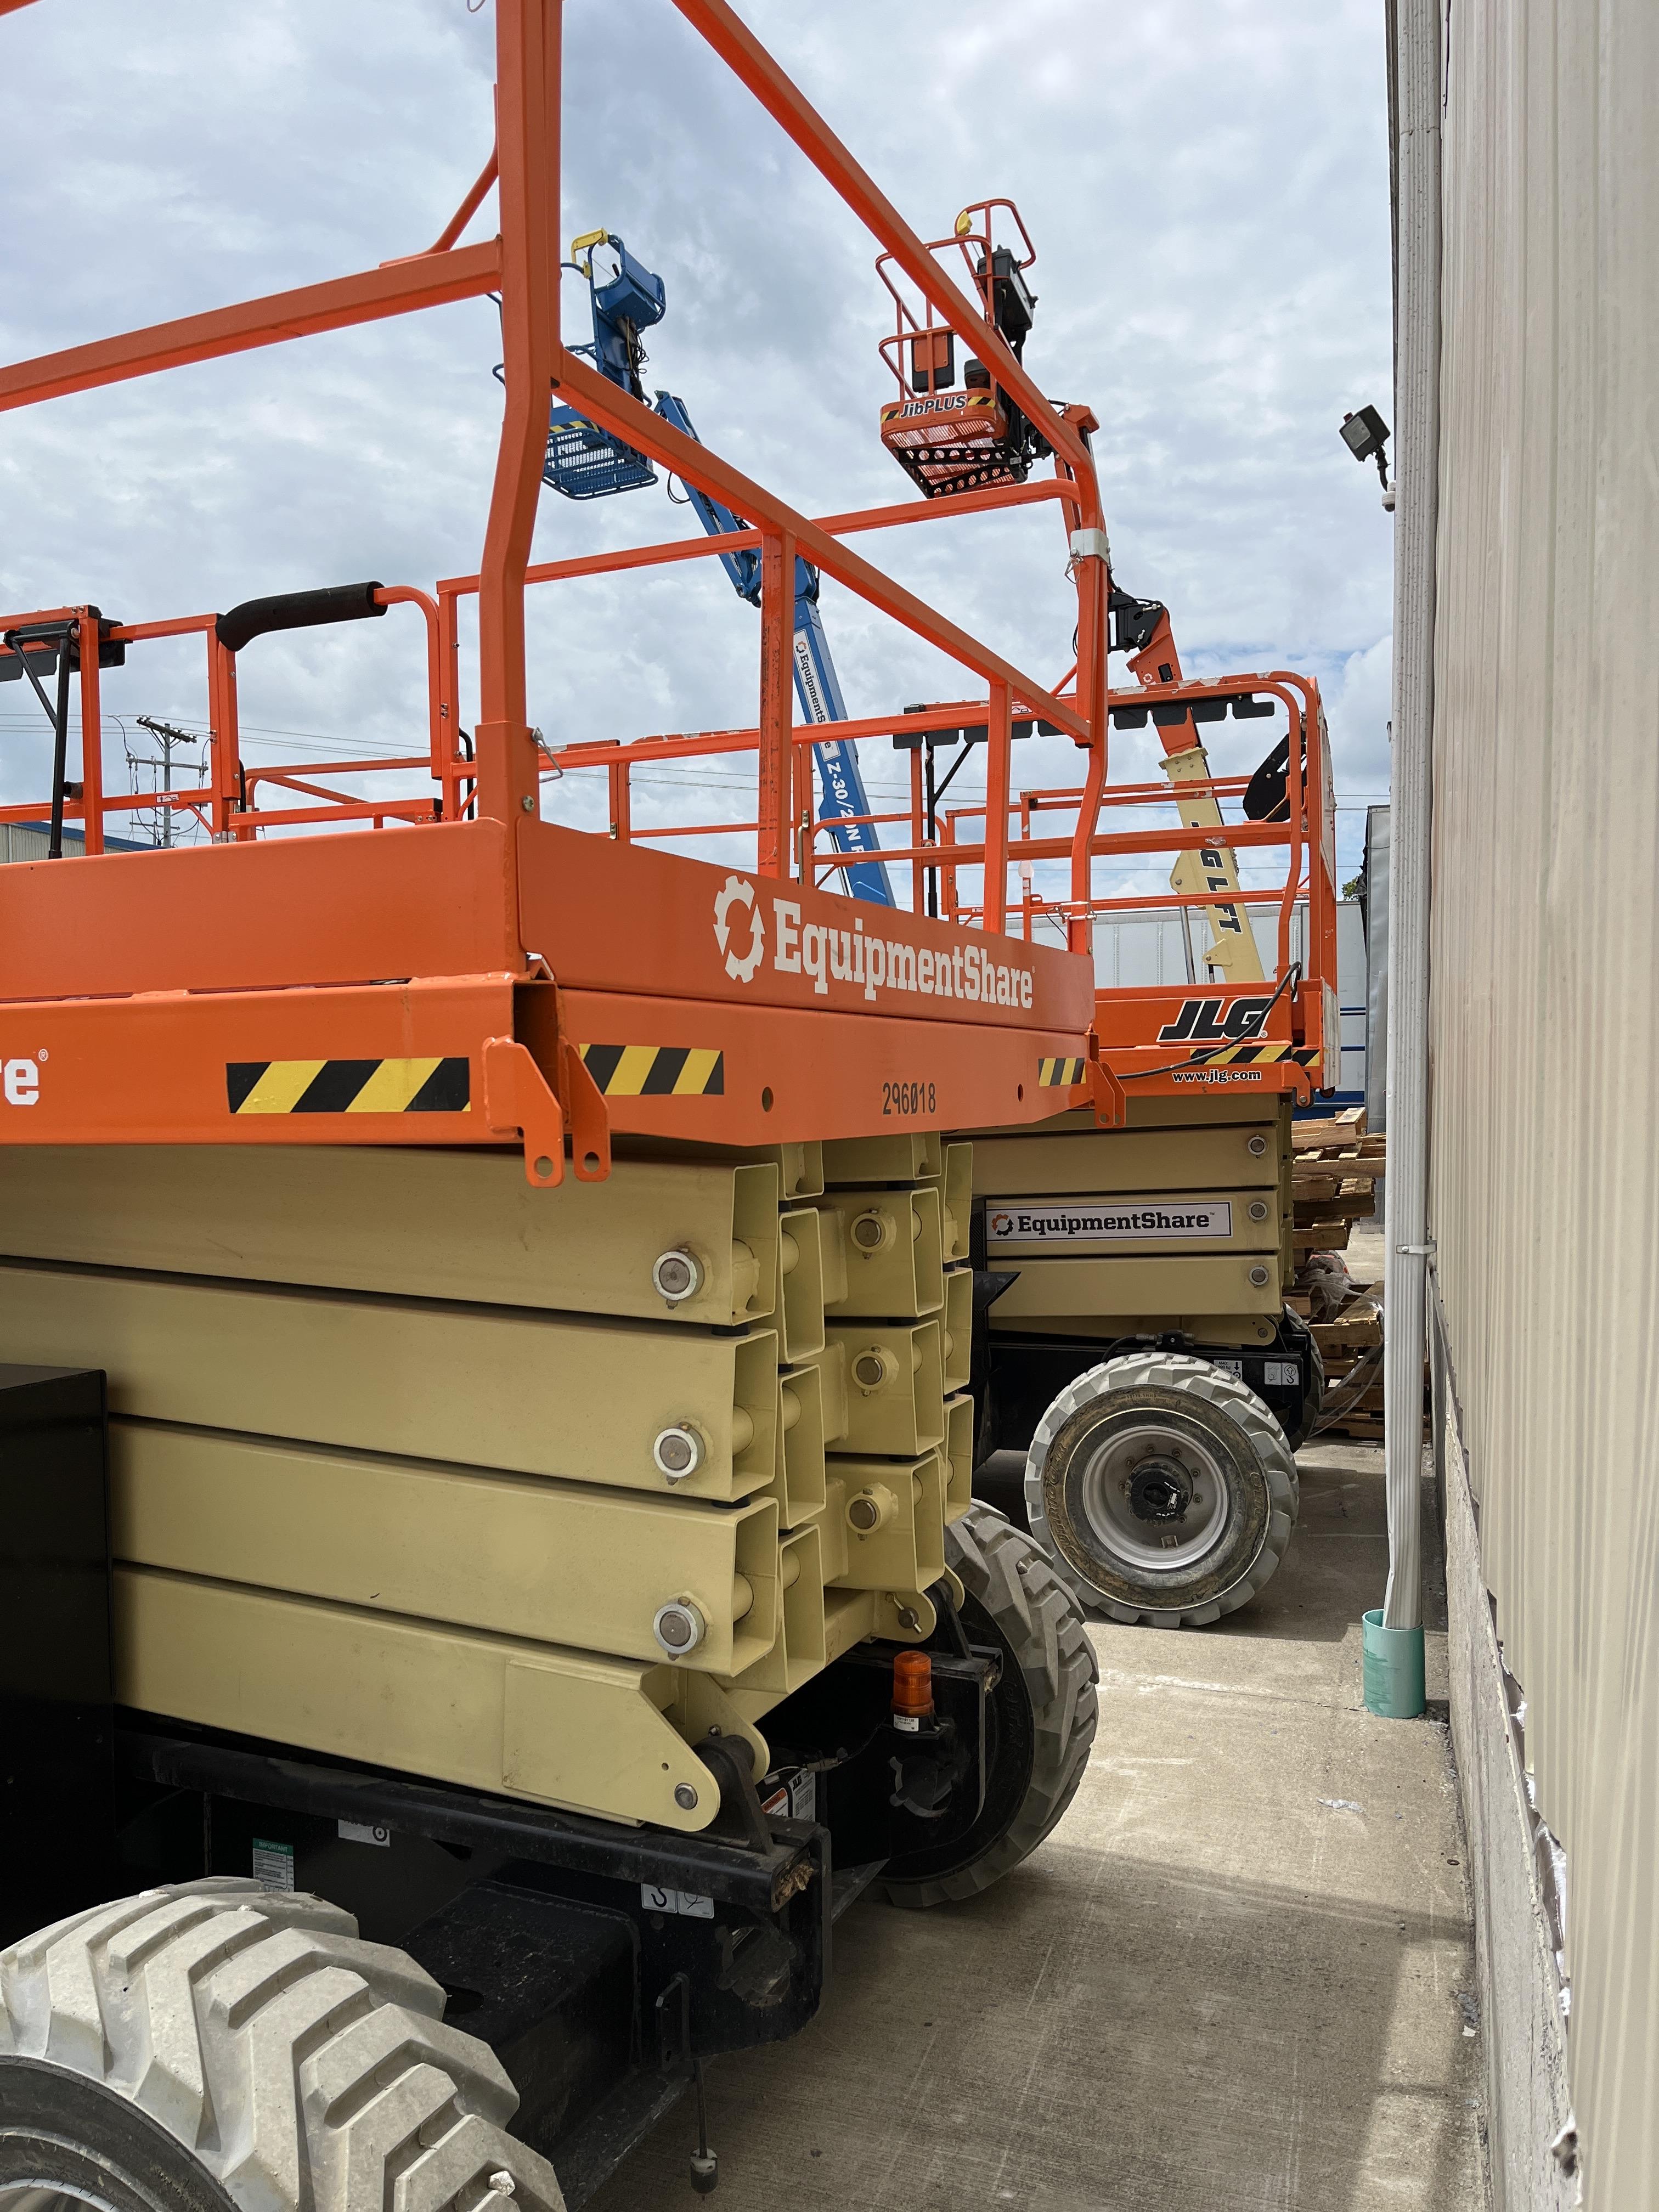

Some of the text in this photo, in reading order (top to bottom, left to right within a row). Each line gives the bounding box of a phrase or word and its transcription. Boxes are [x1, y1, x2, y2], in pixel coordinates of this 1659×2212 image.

[900, 394, 968, 417] JibPLUS
[799, 654, 831, 749] EquipmentSe
[1206, 877, 1243, 934] LFT
[773, 898, 1034, 1009] EquipmentShare
[1156, 997, 1273, 1042] JLG
[1172, 1069, 1262, 1084] www.jlg.com
[882, 1082, 936, 1115] 296018
[1017, 1212, 1210, 1235] EquipmentShare
[258, 1841, 288, 1853] IMPORTANT
